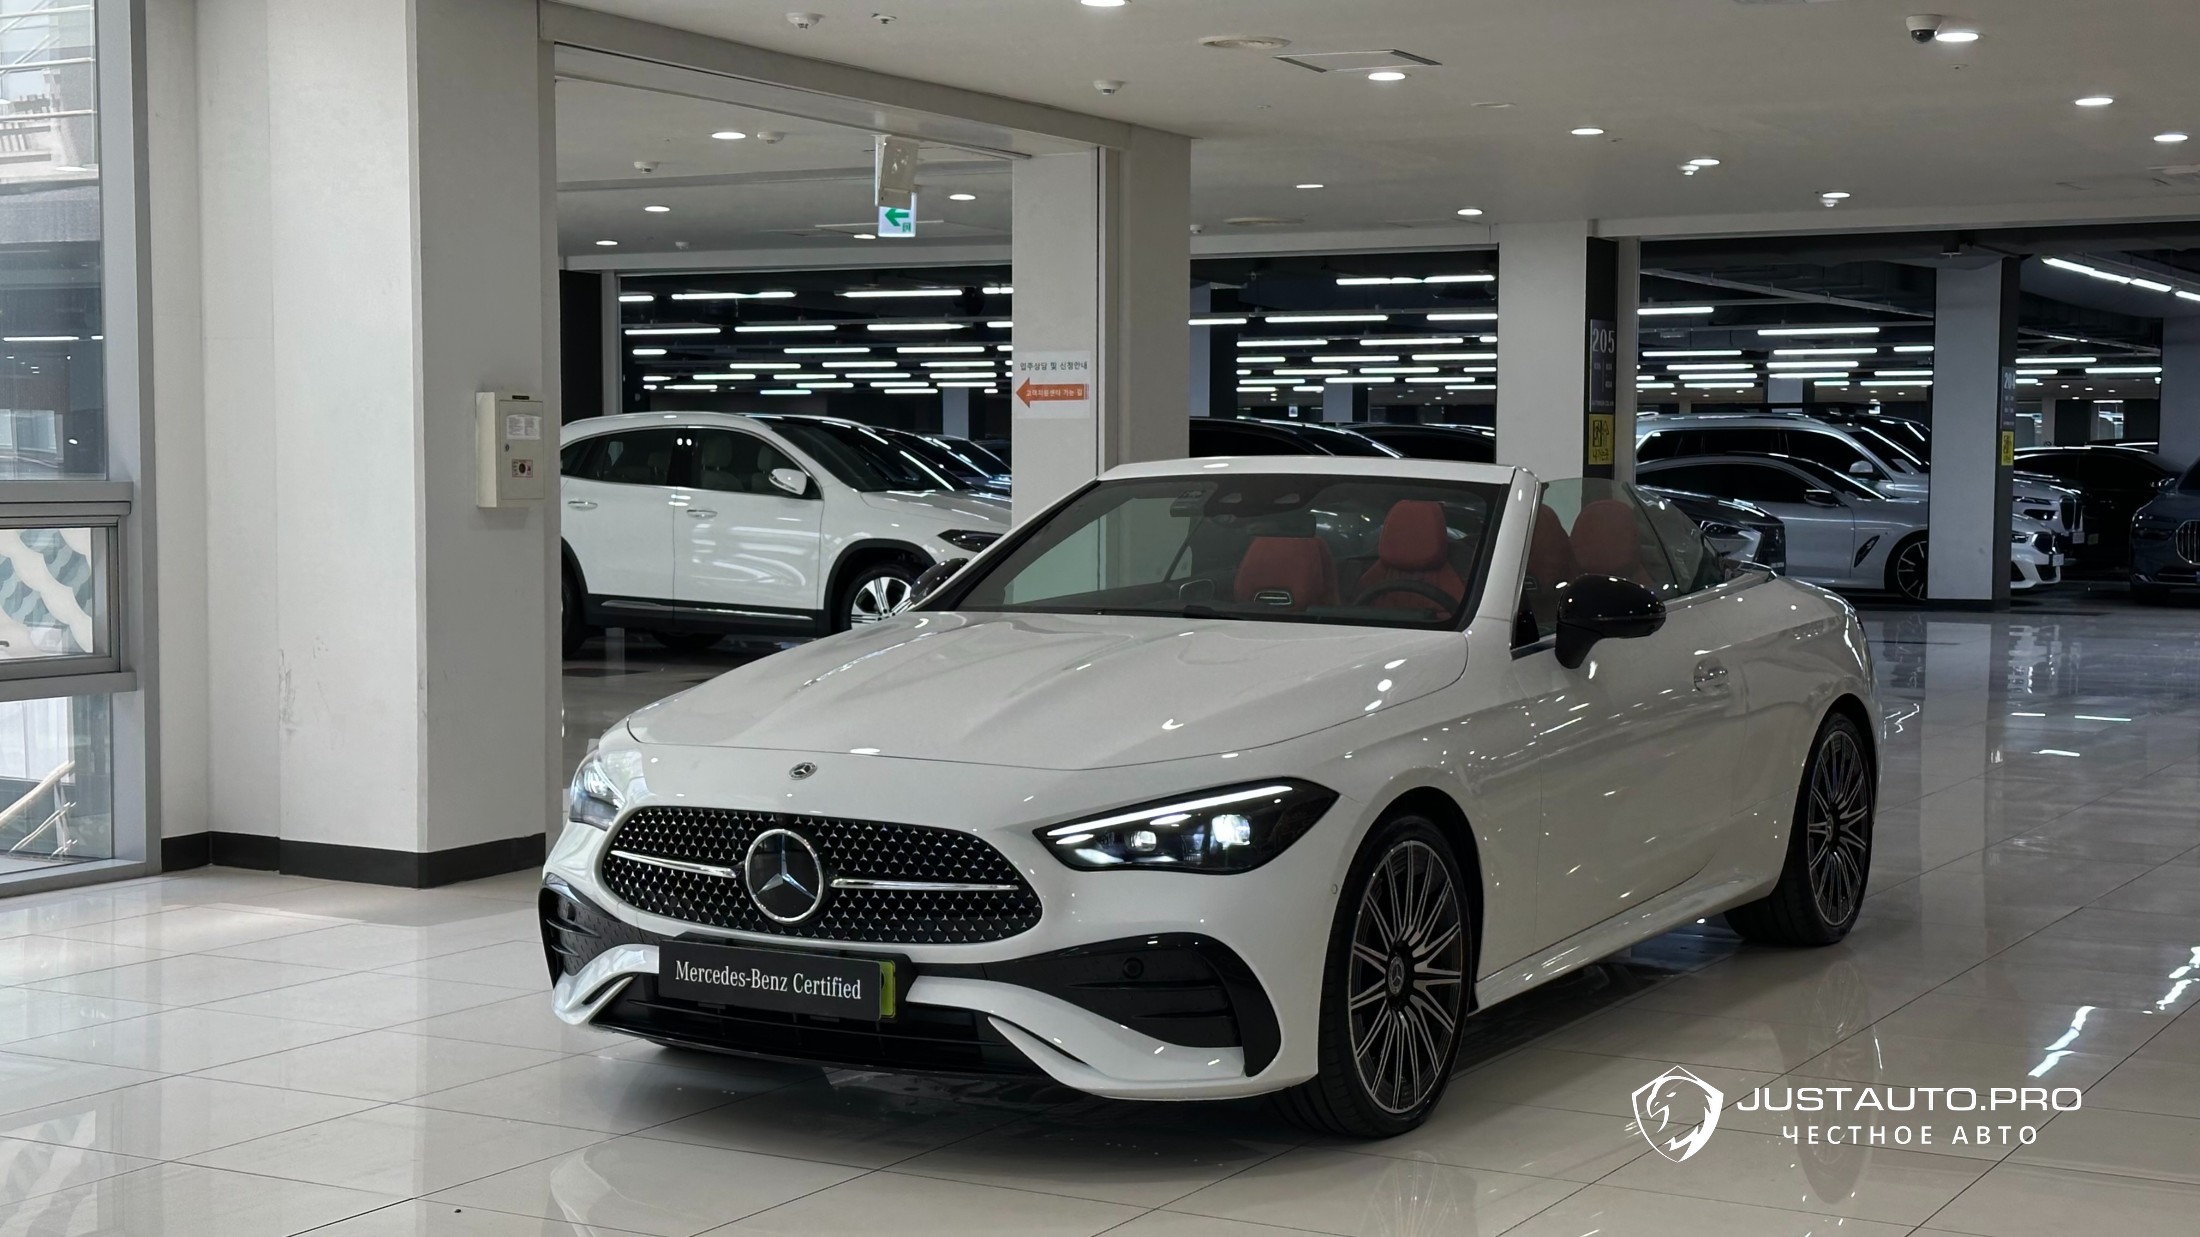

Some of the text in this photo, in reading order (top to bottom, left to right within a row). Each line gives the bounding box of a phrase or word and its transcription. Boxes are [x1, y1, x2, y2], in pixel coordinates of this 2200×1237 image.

[1592, 328, 1615, 353] 205
[1050, 362, 1057, 371] 및
[1060, 361, 1087, 370] 신청안내
[675, 960, 862, 1000] Mercedes-Benz Certified
